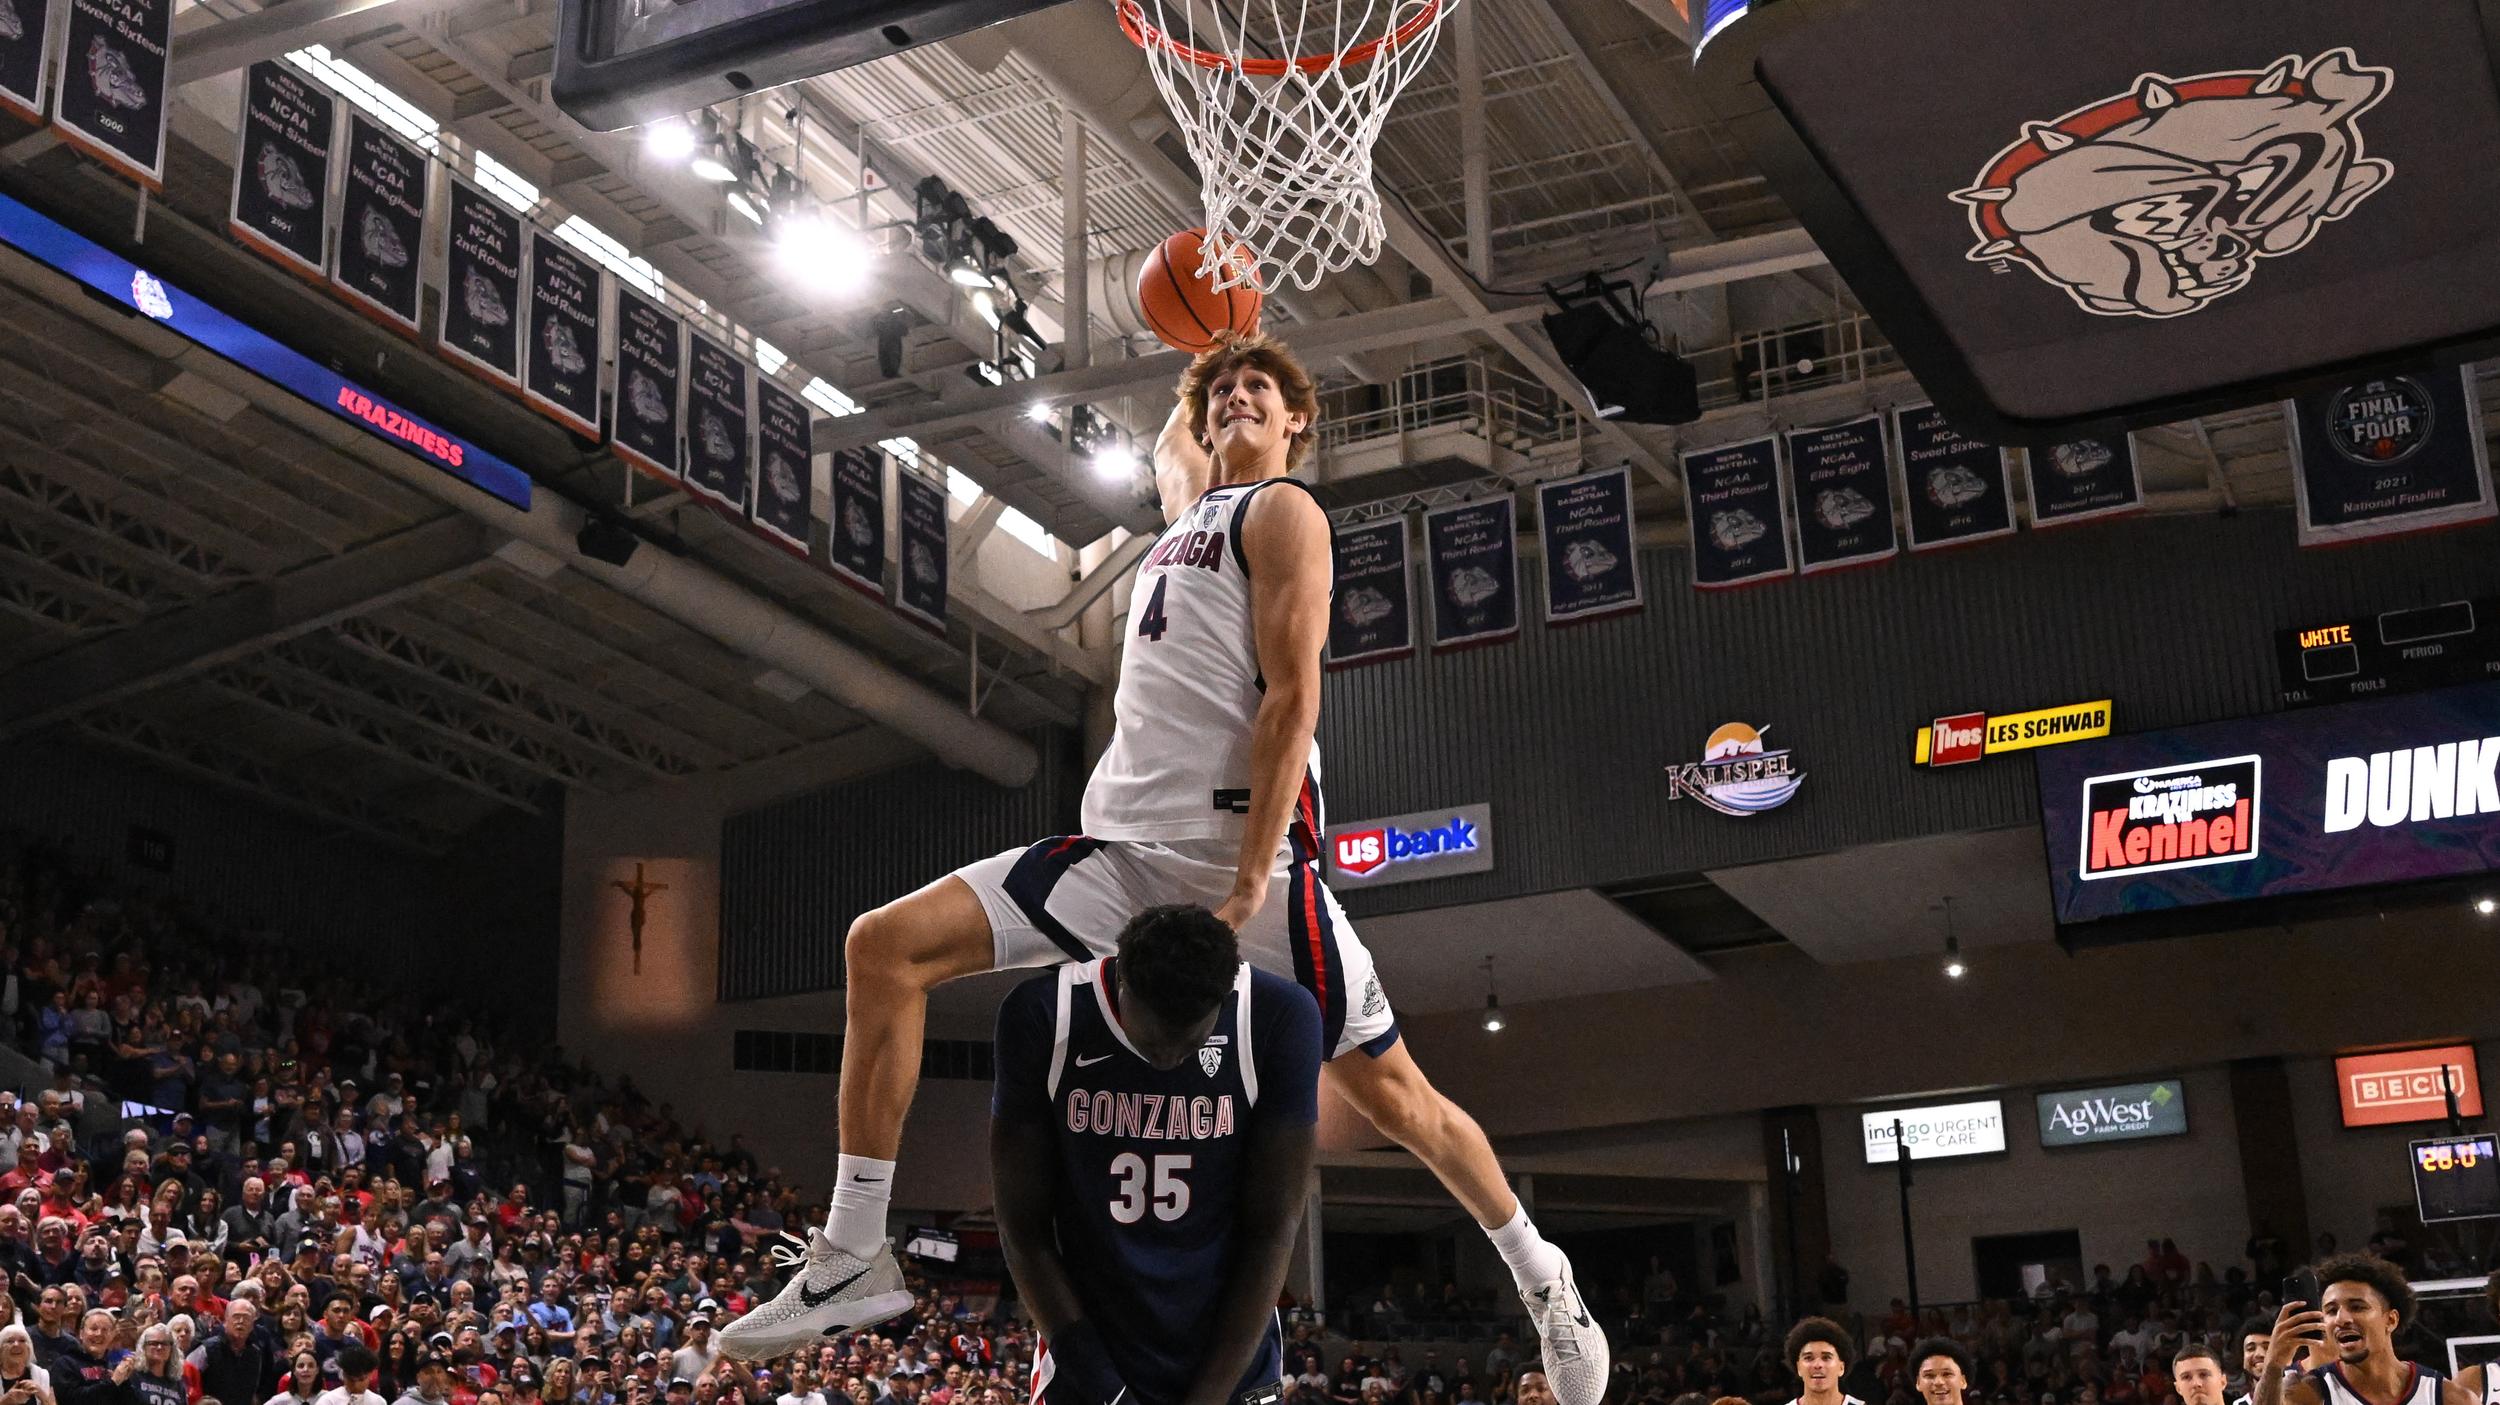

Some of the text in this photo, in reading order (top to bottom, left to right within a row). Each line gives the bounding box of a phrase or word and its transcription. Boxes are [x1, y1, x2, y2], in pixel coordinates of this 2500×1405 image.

[106, 0, 143, 26] CAA
[117, 20, 165, 57] Sixteen
[99, 114, 124, 133] 2000
[270, 97, 309, 132] NCAA
[477, 249, 518, 279] Round
[2348, 394, 2409, 421] FINAL
[337, 386, 463, 467] KRAZINESS
[2352, 415, 2412, 443] FOUR
[1820, 451, 1856, 465] NCAA
[1911, 446, 1947, 461] Sweet
[2374, 476, 2408, 490] 2021
[1569, 504, 1603, 519] NCAA
[2343, 487, 2448, 513] National Finalist
[1555, 514, 1621, 534] Third Round
[1454, 531, 1488, 546] NCAA
[1138, 573, 1167, 642] 4
[2300, 624, 2352, 648] WHITE
[2402, 644, 2443, 660] PERIOD
[2350, 678, 2386, 694] FOULS
[1936, 722, 1982, 754] Tires
[1989, 710, 2106, 744] LES SCHWAB
[1664, 754, 1796, 800] KALISPEL
[2324, 736, 2500, 834] DUNK
[2128, 783, 2237, 820] KRAZINESS
[1339, 817, 1475, 865] us bank
[2091, 798, 2250, 870] Kennel
[2361, 1073, 2456, 1100] BECU
[1067, 1088, 1234, 1140] GONZAGA
[1934, 1116, 1998, 1134] URGENT
[2049, 1098, 2153, 1136] AgWest
[2094, 1120, 2150, 1134] FARM CREDIT
[1935, 1131, 1977, 1147] CARE
[1109, 1152, 1192, 1224] 35
